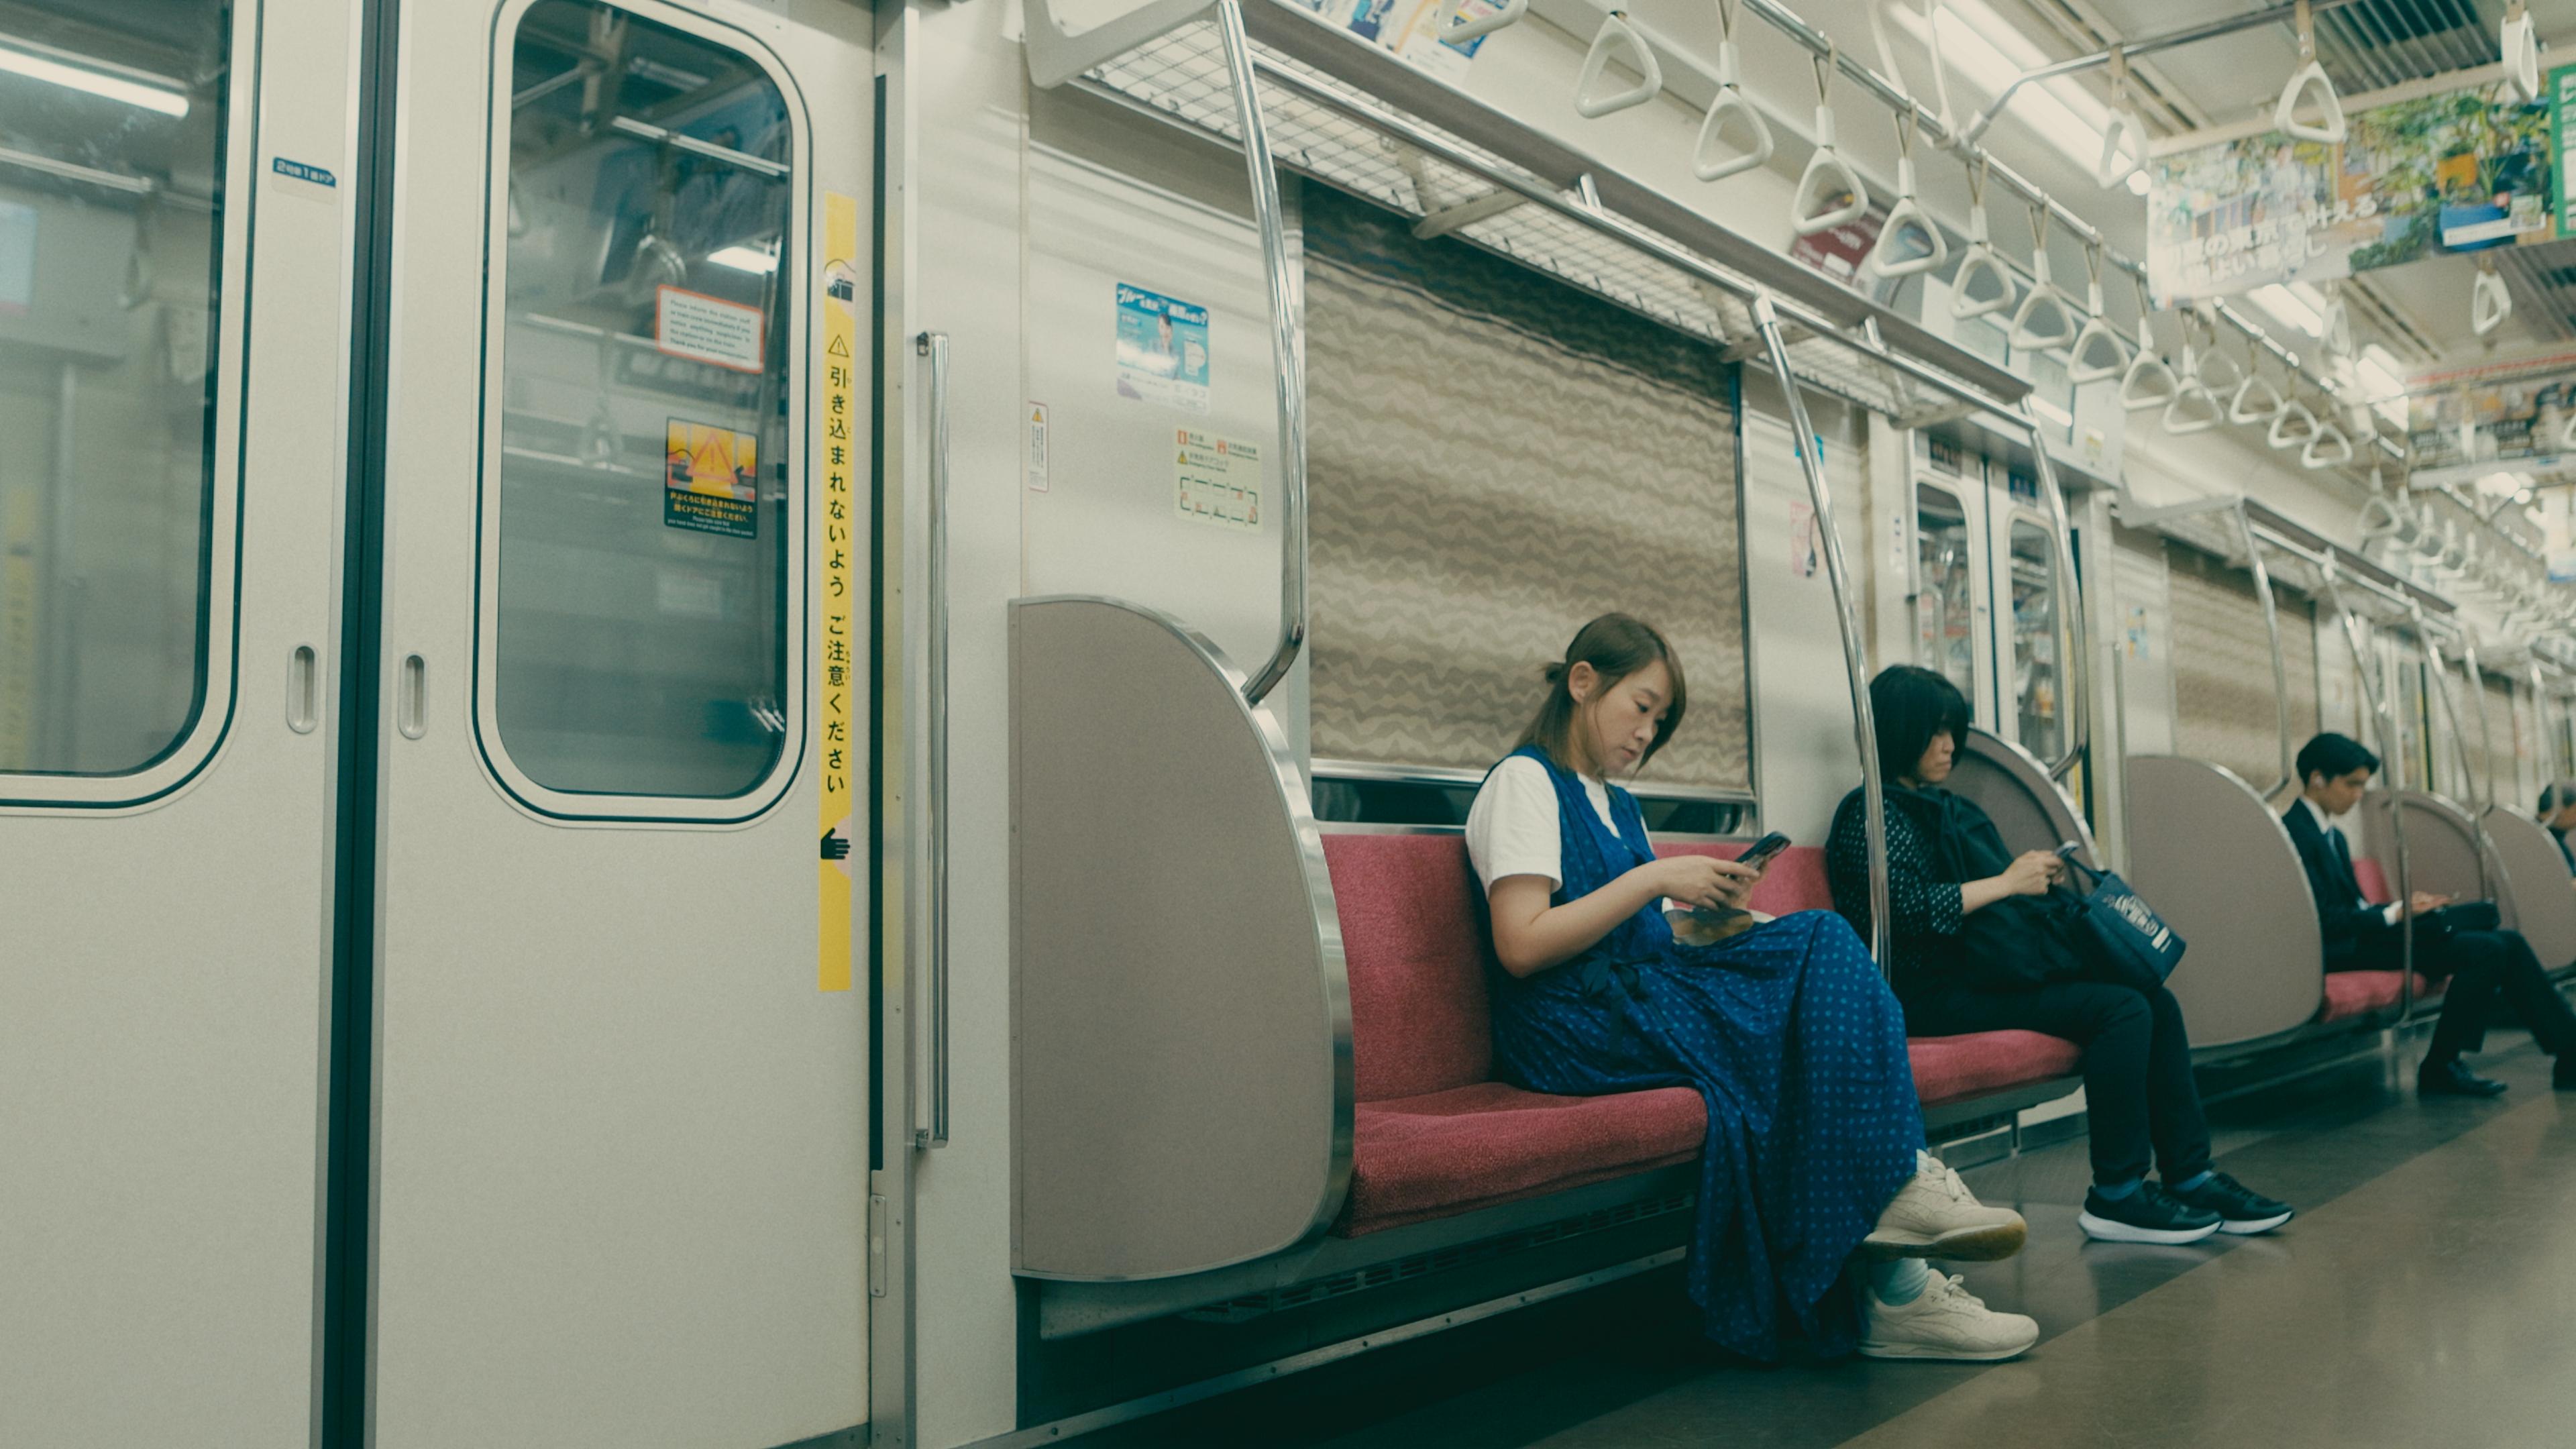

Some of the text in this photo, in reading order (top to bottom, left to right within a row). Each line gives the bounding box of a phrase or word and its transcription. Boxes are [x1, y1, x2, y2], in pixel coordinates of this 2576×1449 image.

[2165, 235, 2327, 288] 地よい暮らし
[827, 366, 847, 793] 引き込まれないよう ご注意ください
